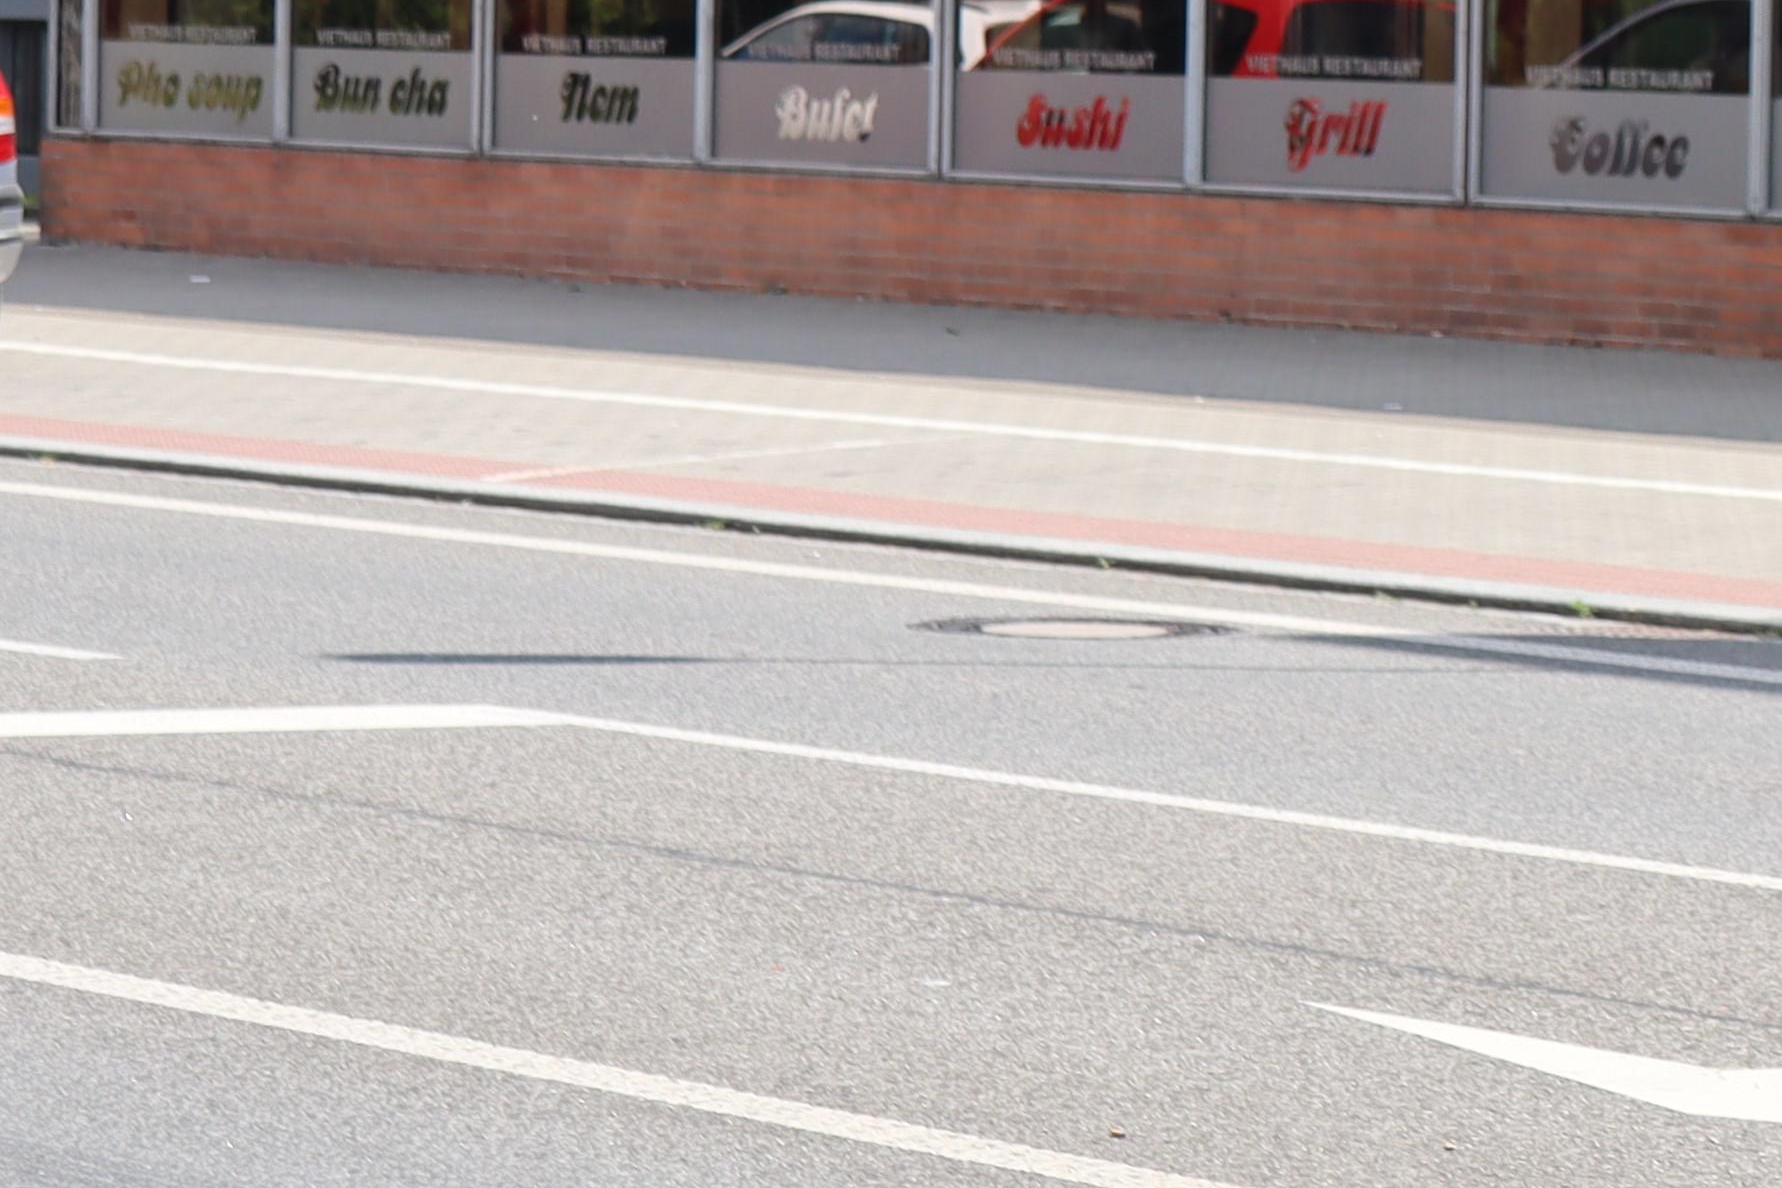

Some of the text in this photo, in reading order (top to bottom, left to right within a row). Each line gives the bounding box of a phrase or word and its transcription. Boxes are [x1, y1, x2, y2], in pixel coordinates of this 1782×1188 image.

[314, 62, 450, 116] Bun cha
[1247, 54, 1422, 77] VIETHAUS RESTAURANT
[1608, 68, 1714, 89] RESTAURANT
[1016, 93, 1131, 152] Sushi
[1284, 97, 1389, 173] Grill
[1549, 115, 1690, 180] Coffee
